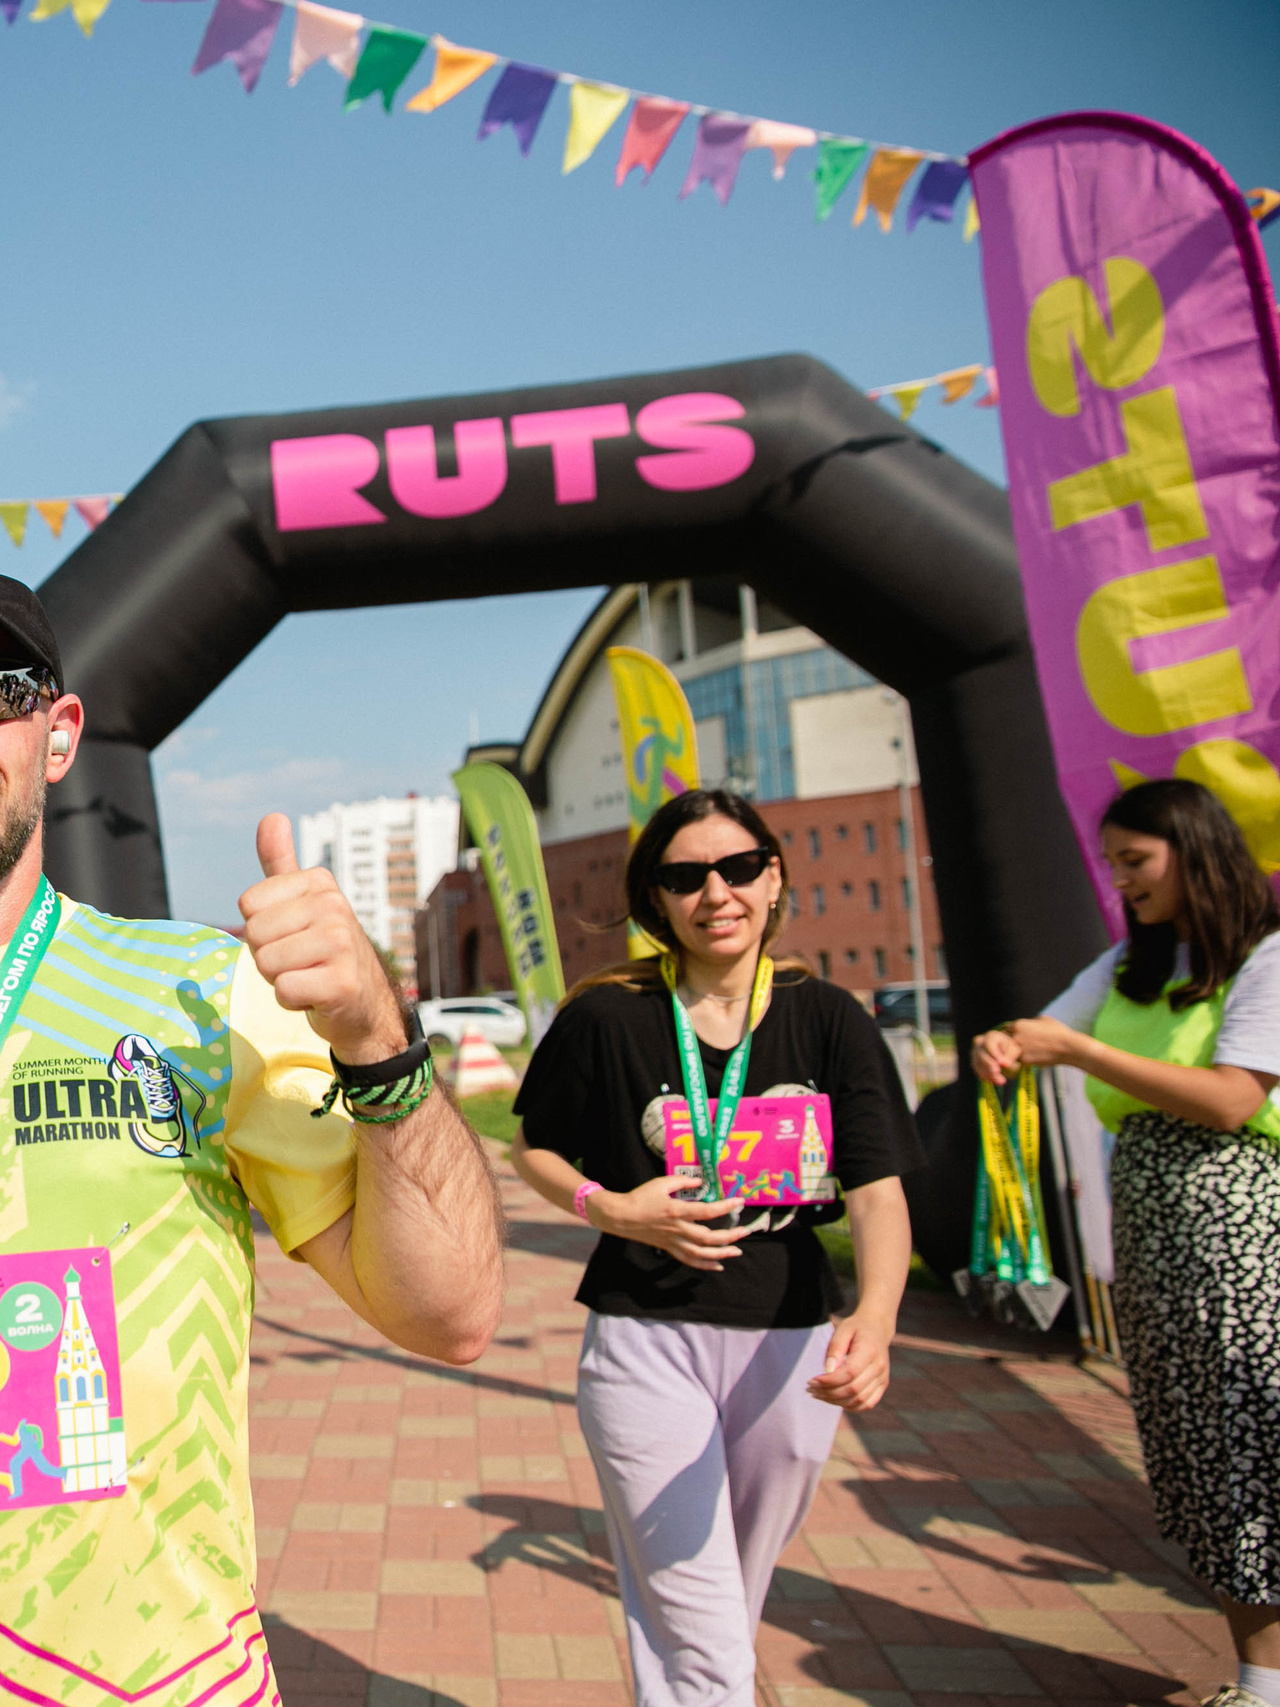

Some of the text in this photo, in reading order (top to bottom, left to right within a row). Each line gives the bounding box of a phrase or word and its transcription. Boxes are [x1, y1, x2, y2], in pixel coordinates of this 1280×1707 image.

[270, 391, 756, 532] RUTS
[17, 932, 41, 959] ПО
[12, 1057, 107, 1072] SUMMER MONTH
[12, 1066, 84, 1081] OF RUNNING
[13, 1079, 149, 1123] ULTRA
[15, 1121, 122, 1146] MARATHON
[778, 1119, 795, 1134] 3
[15, 1293, 43, 1323] 2
[7, 1323, 54, 1338] ВОЛНА
